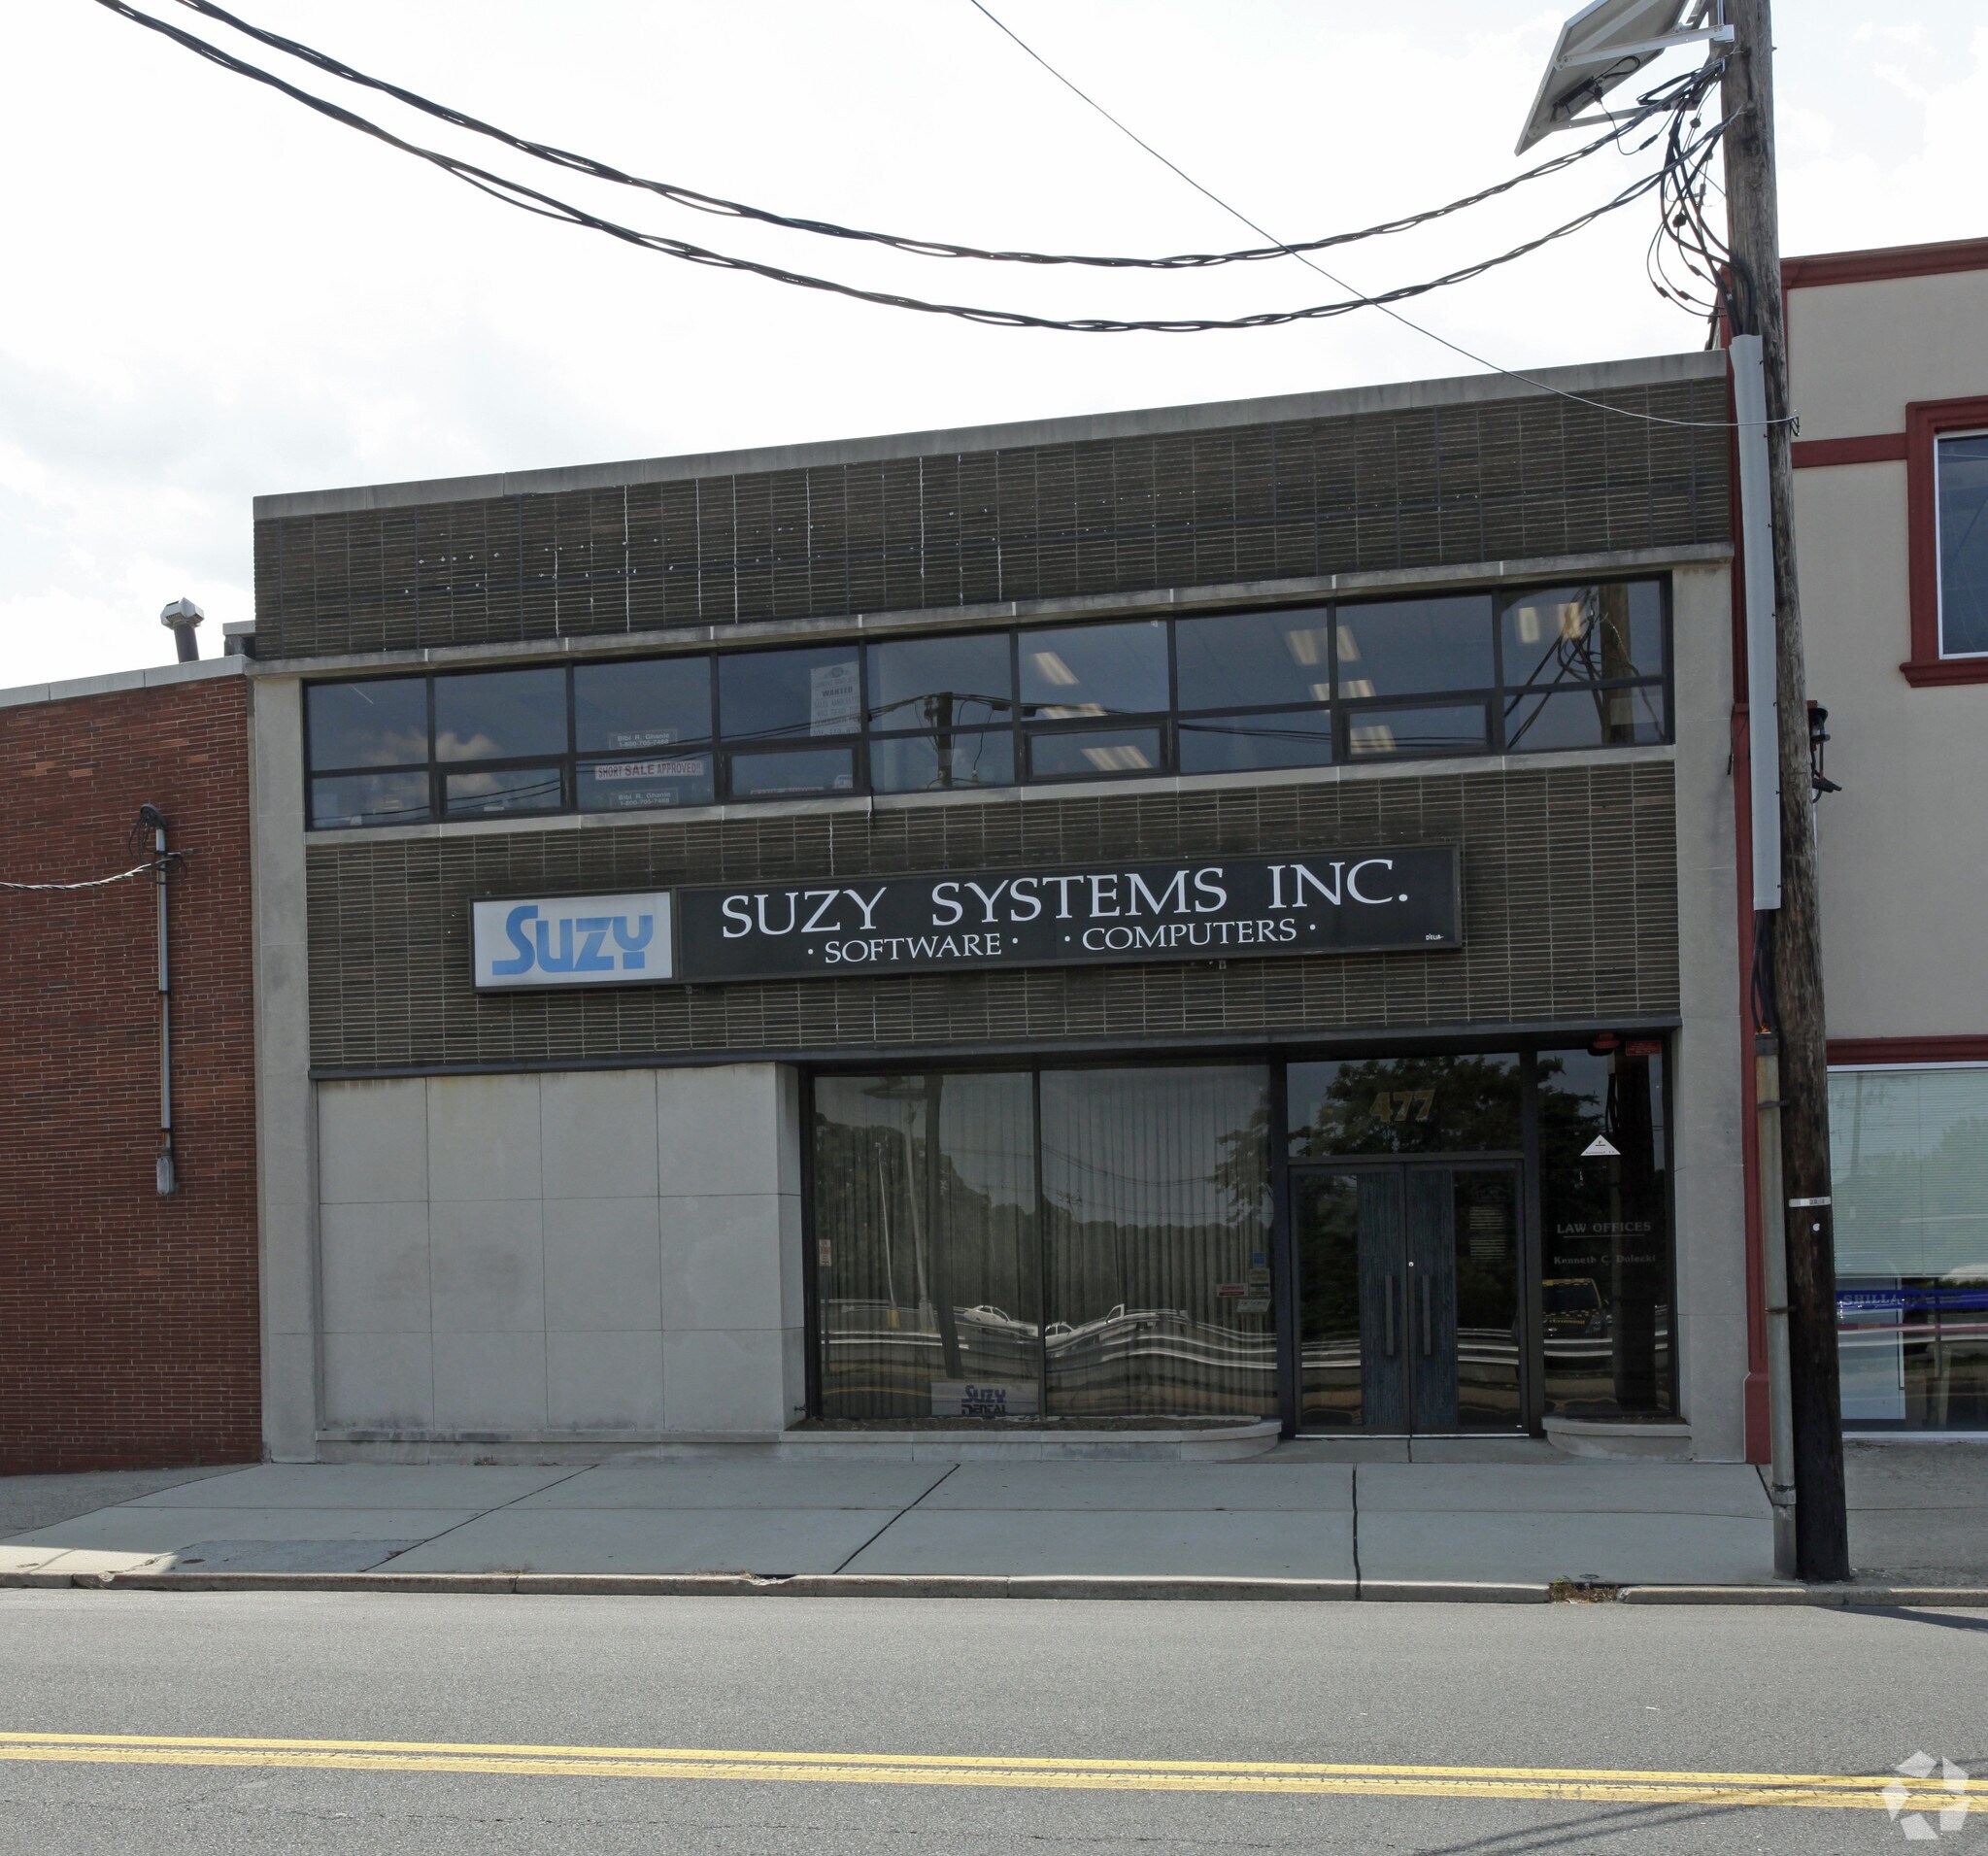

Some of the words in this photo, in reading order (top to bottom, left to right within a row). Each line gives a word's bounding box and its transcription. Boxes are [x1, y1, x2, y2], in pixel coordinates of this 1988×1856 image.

[597, 765, 623, 778] SHORT
[624, 764, 655, 776] SALE
[657, 762, 701, 775] APPROVED!!
[722, 887, 888, 938] SUZY
[931, 867, 1227, 926] SYSTEMS
[1267, 859, 1408, 909] INC.
[492, 905, 654, 975] SUZY
[825, 933, 1002, 963] SOFTWARE
[1082, 918, 1297, 951] COMPUTERS
[1369, 1089, 1435, 1122] 477
[1557, 1223, 1587, 1234] LAW
[1593, 1221, 1652, 1233] OFFICES
[1554, 1256, 1597, 1265] Kenneth
[1843, 1293, 1901, 1305] SHILLA
[961, 1385, 1006, 1403] SUZY
